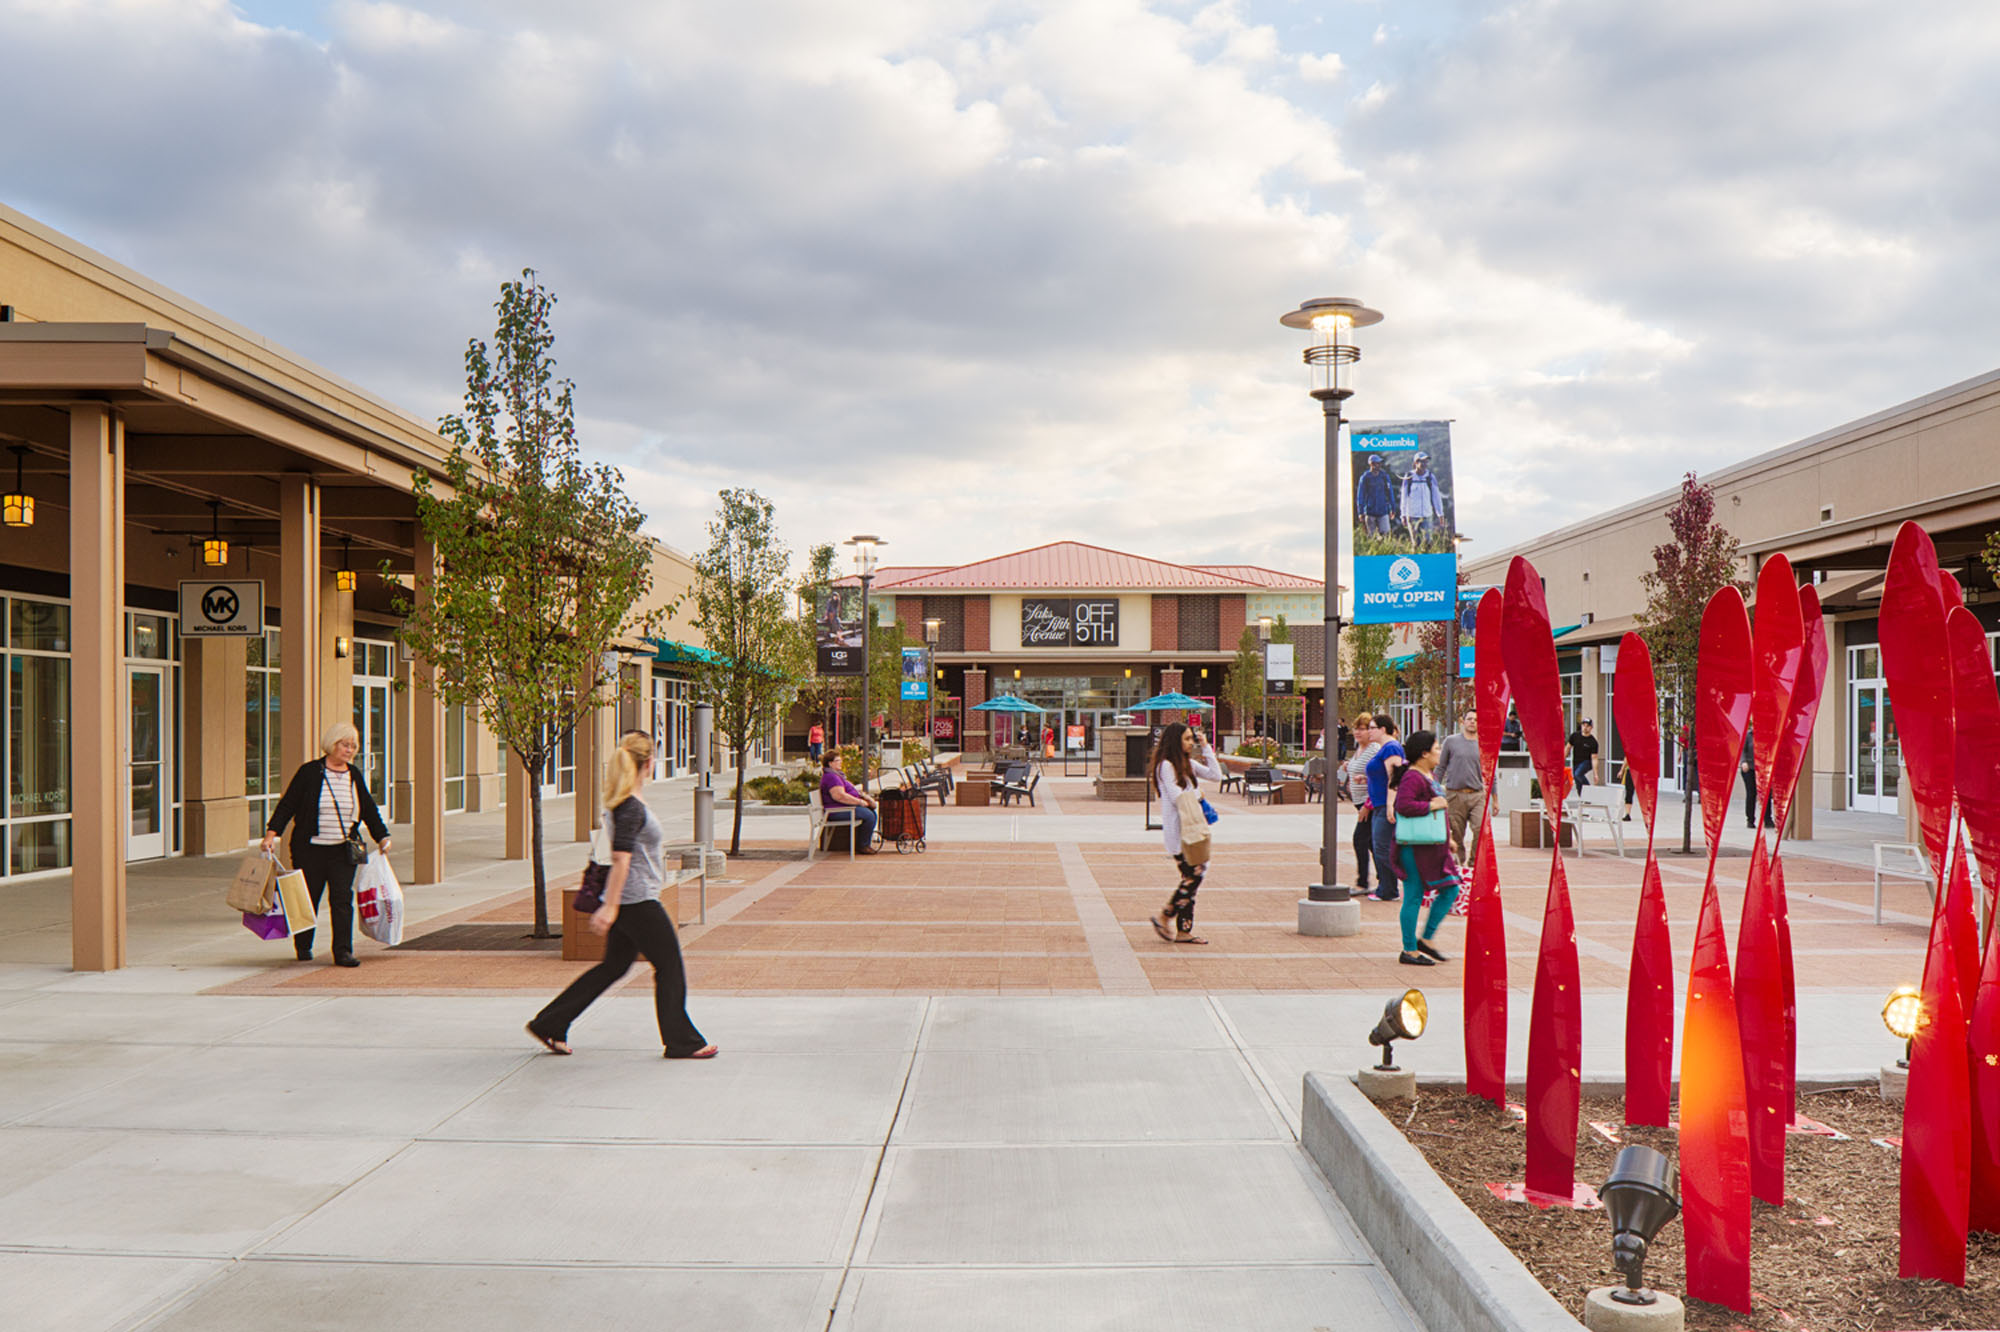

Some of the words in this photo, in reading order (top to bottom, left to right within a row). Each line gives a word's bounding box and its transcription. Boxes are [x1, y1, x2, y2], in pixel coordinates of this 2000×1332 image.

[1370, 437, 1415, 447] Columbia
[206, 597, 236, 614] MK
[1363, 592, 1400, 604] NOW
[1403, 591, 1445, 603] OPEN
[1023, 604, 1053, 623] Saks
[1076, 604, 1114, 622] OFF
[1043, 616, 1070, 632] Fifth
[1076, 622, 1114, 641] 5TH
[1022, 624, 1066, 642] Avenue
[831, 651, 848, 659] UGG
[934, 721, 952, 729] 70%
[934, 729, 952, 737] OFF
